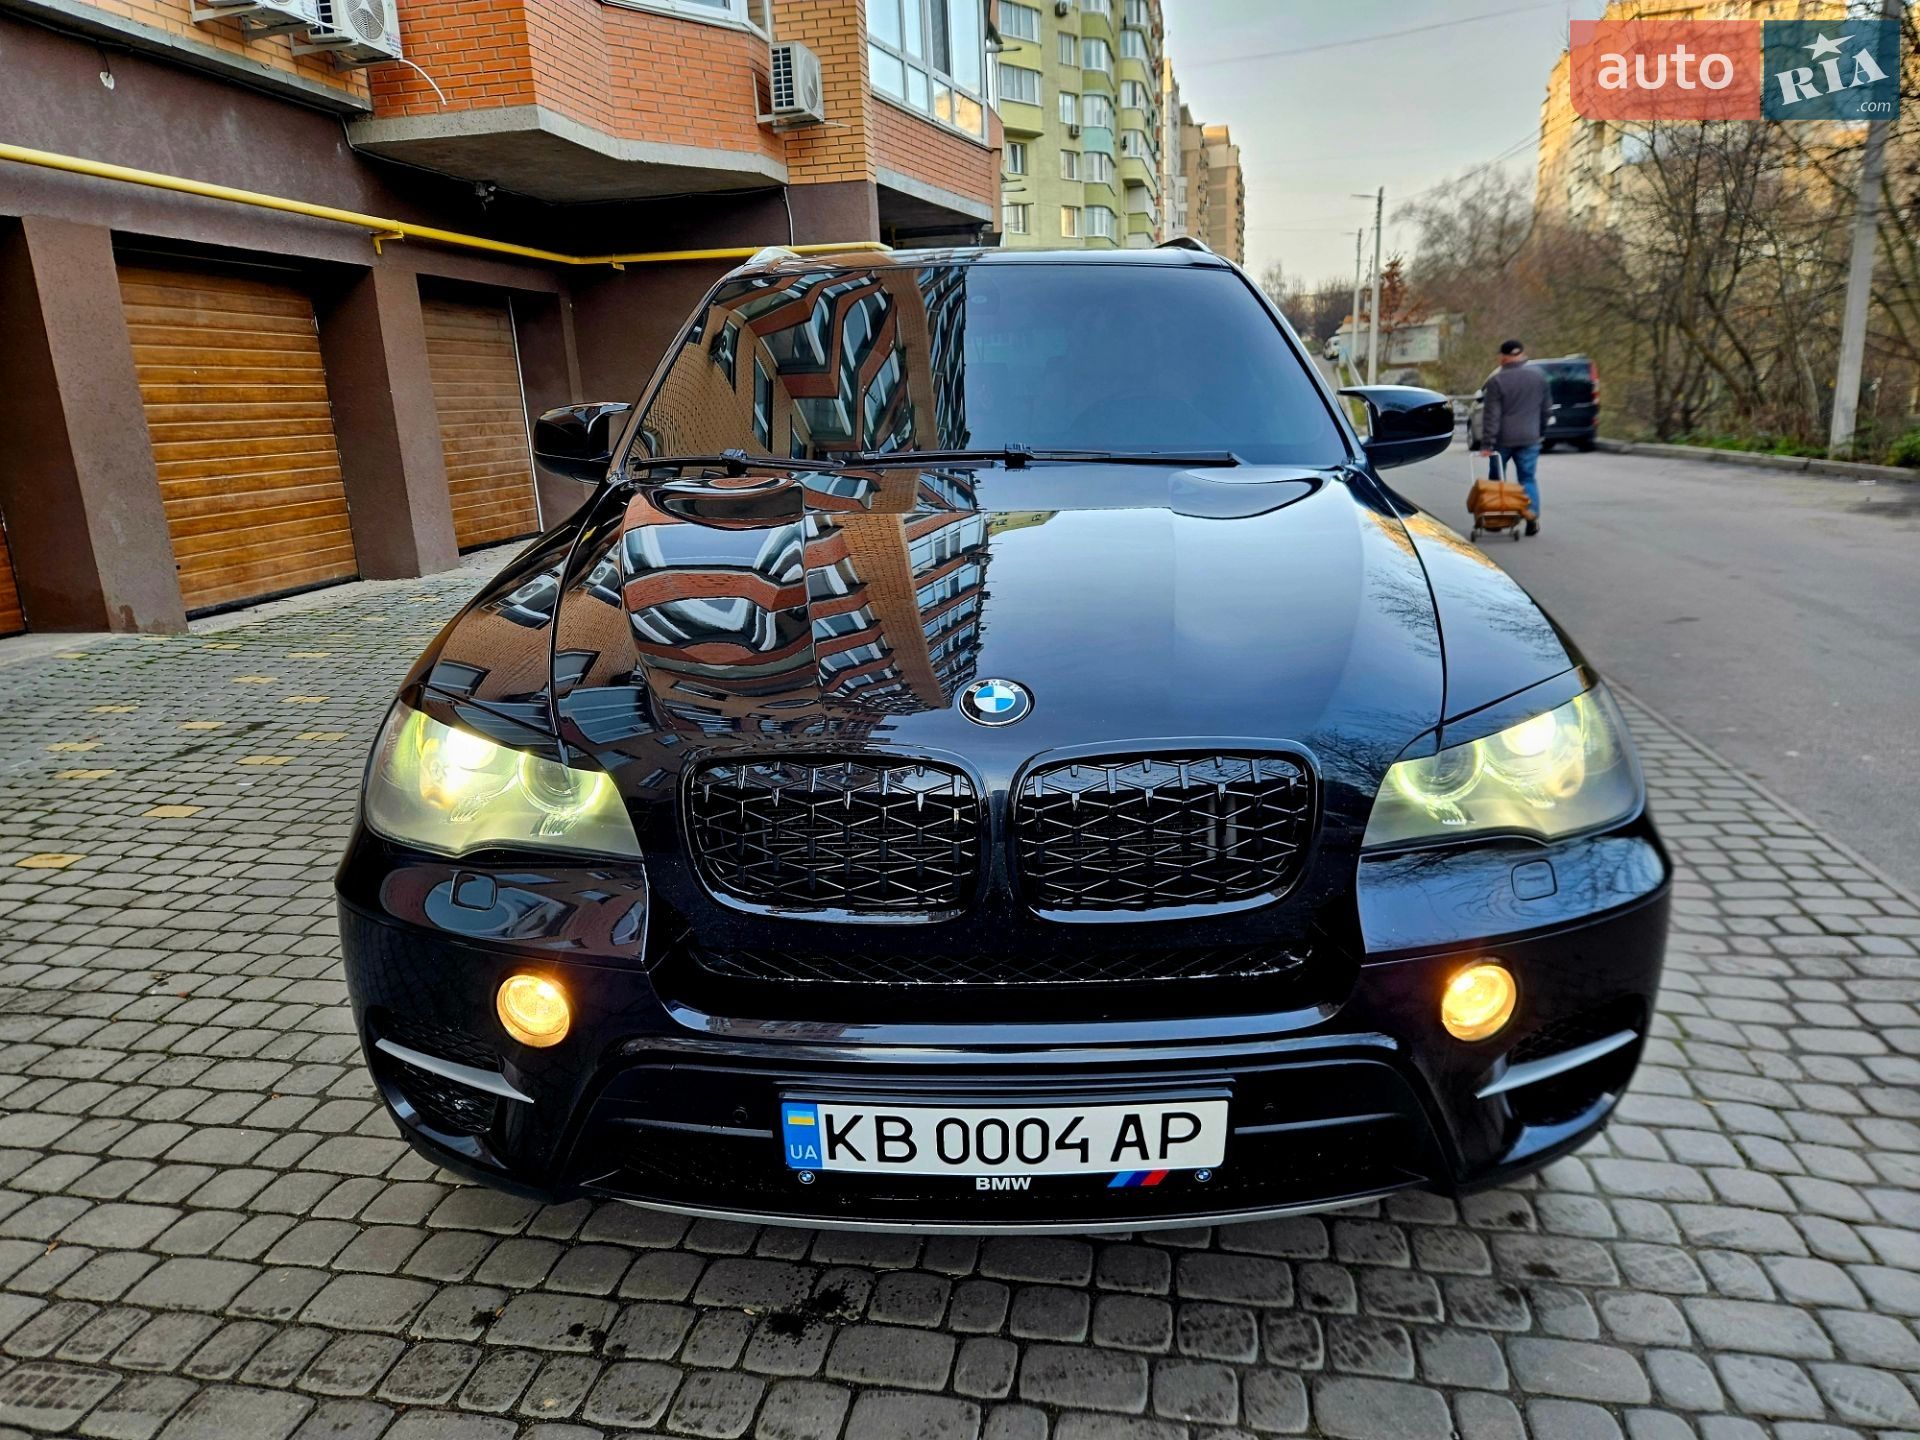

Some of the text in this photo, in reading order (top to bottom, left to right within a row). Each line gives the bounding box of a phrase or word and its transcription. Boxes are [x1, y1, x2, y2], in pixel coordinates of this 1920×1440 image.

[825, 1112, 1202, 1165] KB 0004 AP
[790, 1144, 818, 1160] UA
[975, 1177, 1031, 1191] BMW
